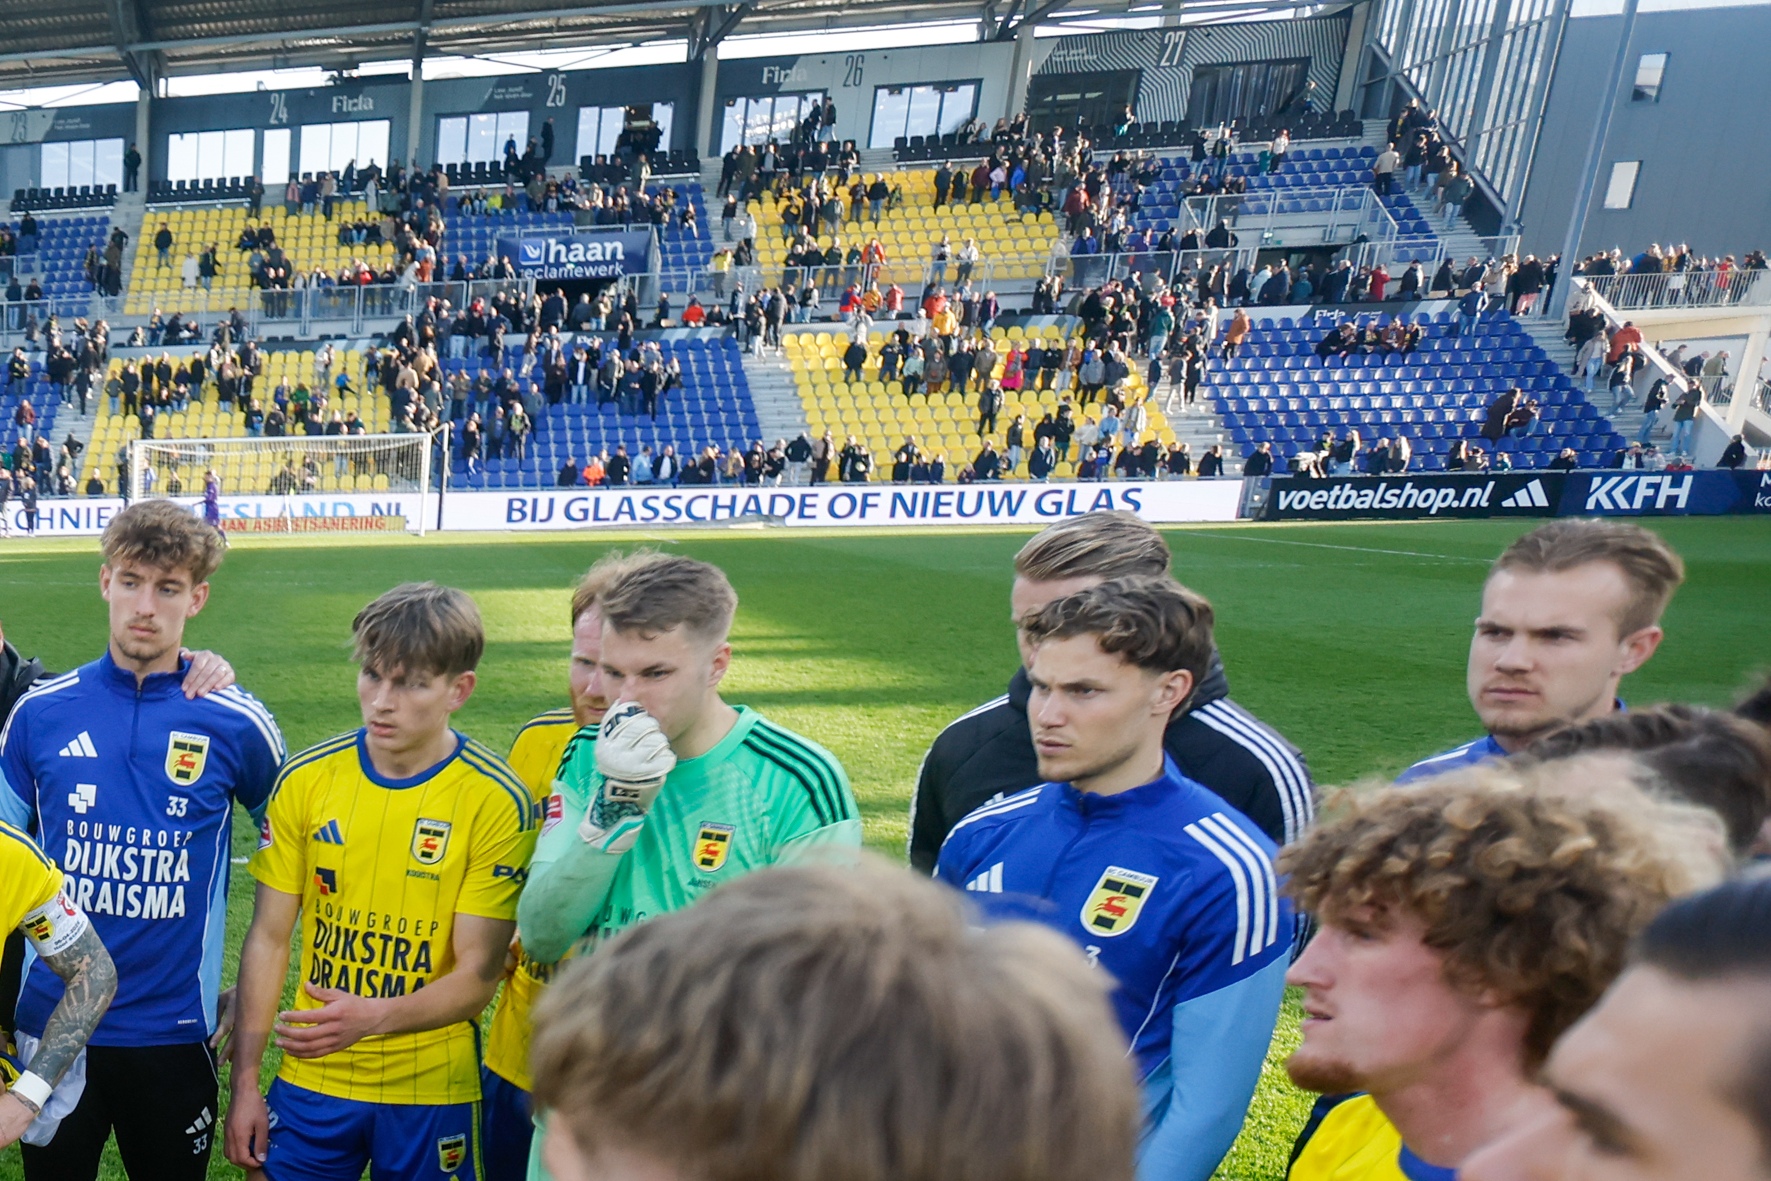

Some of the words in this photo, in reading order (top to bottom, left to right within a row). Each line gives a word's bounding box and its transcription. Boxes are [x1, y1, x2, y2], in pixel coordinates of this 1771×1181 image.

[1160, 32, 1186, 67] 27
[843, 55, 865, 87] 26
[546, 74, 567, 107] 25
[269, 94, 288, 124] 24
[548, 238, 625, 263] haan
[506, 497, 555, 524] BIJ
[563, 493, 819, 523] GLASSCHADE
[827, 492, 881, 519] OF
[889, 489, 1028, 519] NIEUW
[1034, 487, 1143, 516] GLAS
[1278, 480, 1496, 515] voetbalshop.nl
[166, 795, 189, 817] 33
[66, 819, 193, 848] BOUWGROEP
[64, 838, 191, 883] DIJKSTRA
[63, 873, 186, 919] DRAISMA
[316, 899, 439, 937] BOUWGROEP
[313, 917, 432, 974] DIJKSTRA
[193, 1133, 208, 1155] 33
